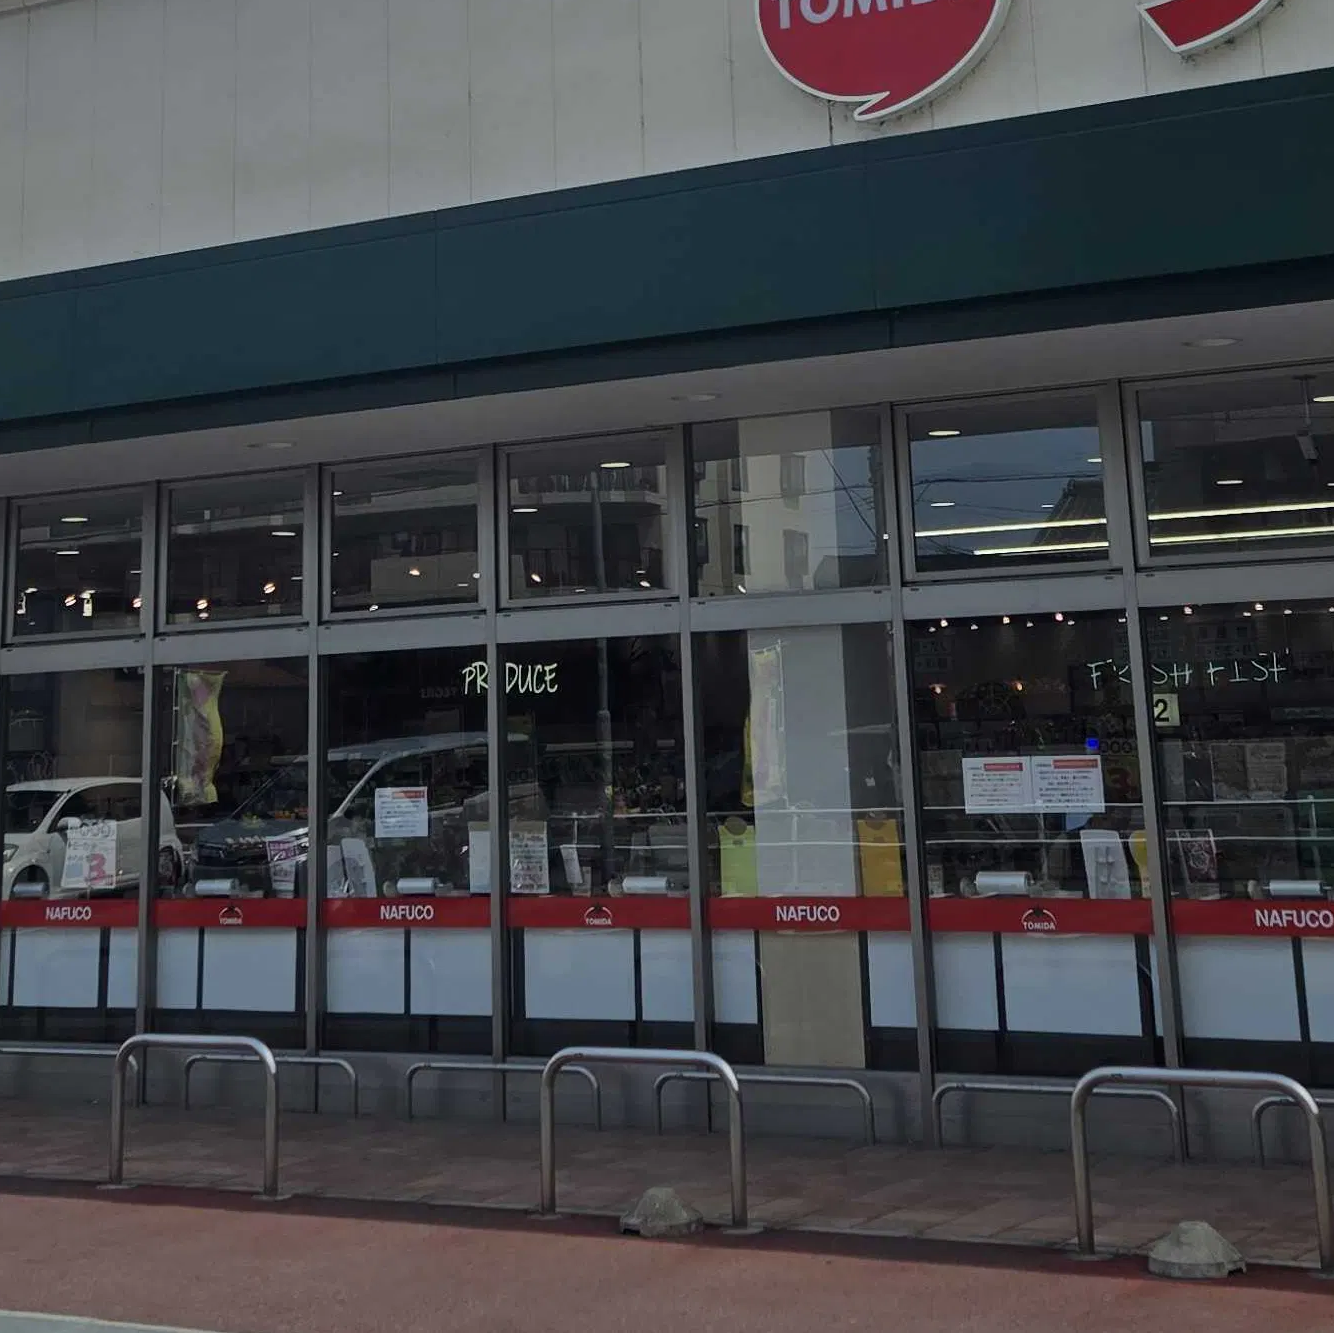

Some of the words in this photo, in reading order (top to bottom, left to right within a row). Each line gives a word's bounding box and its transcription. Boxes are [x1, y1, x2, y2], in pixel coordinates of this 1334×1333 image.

[462, 660, 558, 695] PRDUCE
[46, 905, 92, 921] NAFUCO
[380, 904, 434, 921] NAFUCO
[776, 905, 840, 922] NAFUCO
[1255, 908, 1334, 928] NAFUCO
[1022, 920, 1057, 931] TOMIDA
